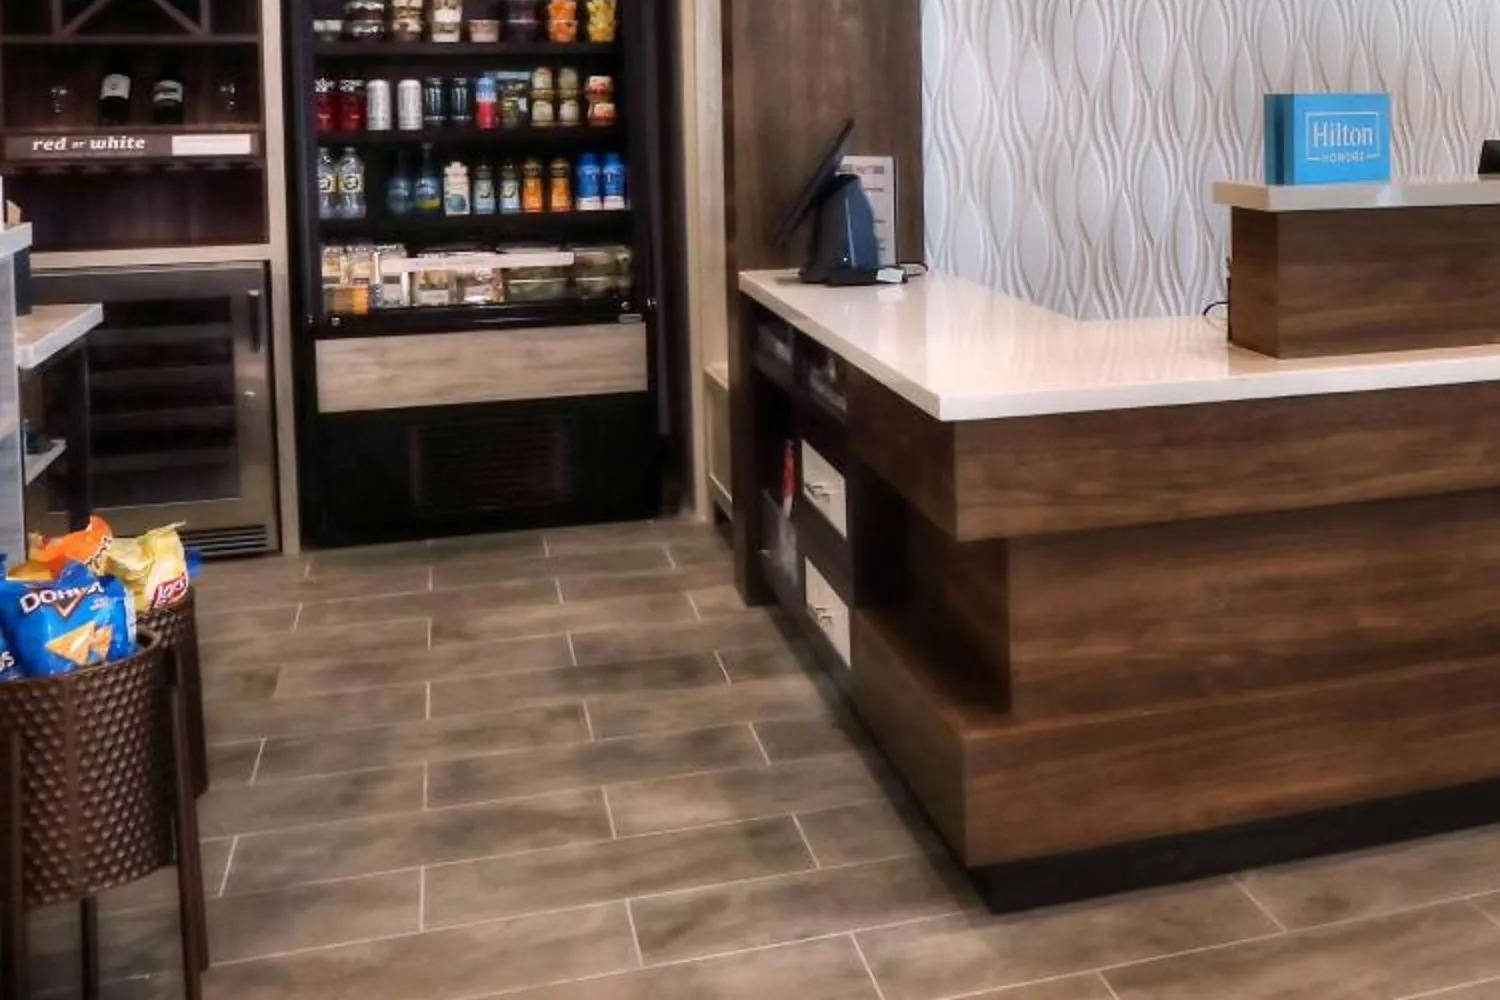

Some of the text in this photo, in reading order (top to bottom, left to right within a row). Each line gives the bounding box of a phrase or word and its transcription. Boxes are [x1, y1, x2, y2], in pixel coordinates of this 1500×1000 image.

[32, 135, 145, 151] red or white
[1313, 121, 1373, 148] Hilton
